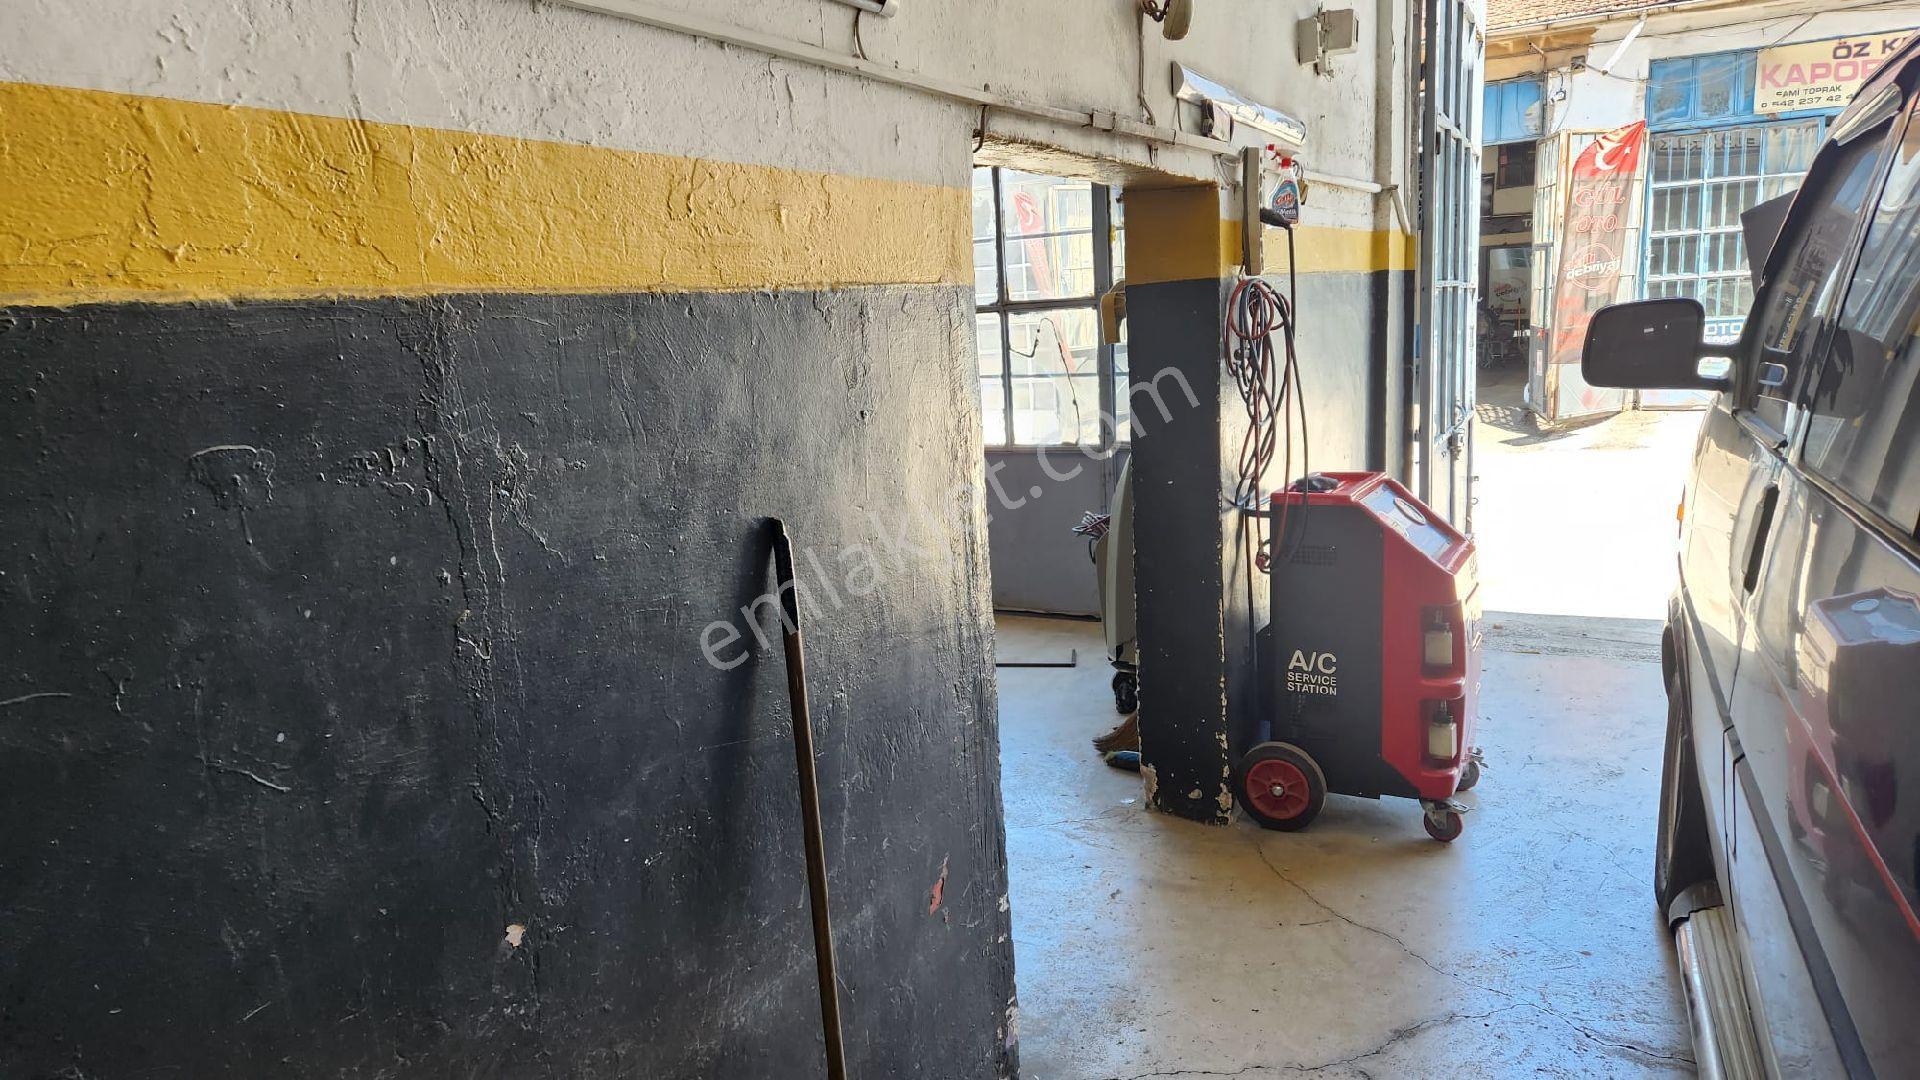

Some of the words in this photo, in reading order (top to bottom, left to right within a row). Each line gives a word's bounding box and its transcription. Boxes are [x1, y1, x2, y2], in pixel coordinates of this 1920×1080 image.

[1832, 41, 1871, 60] ÖZ
[1881, 36, 1909, 55] K
[1804, 84, 1842, 95] TOPRAK
[1799, 96, 1822, 105] 237
[1826, 94, 1842, 102] 42
[1288, 650, 1337, 674] A/C
[1287, 672, 1337, 686] SERVICE
[1287, 682, 1337, 696] STATION
